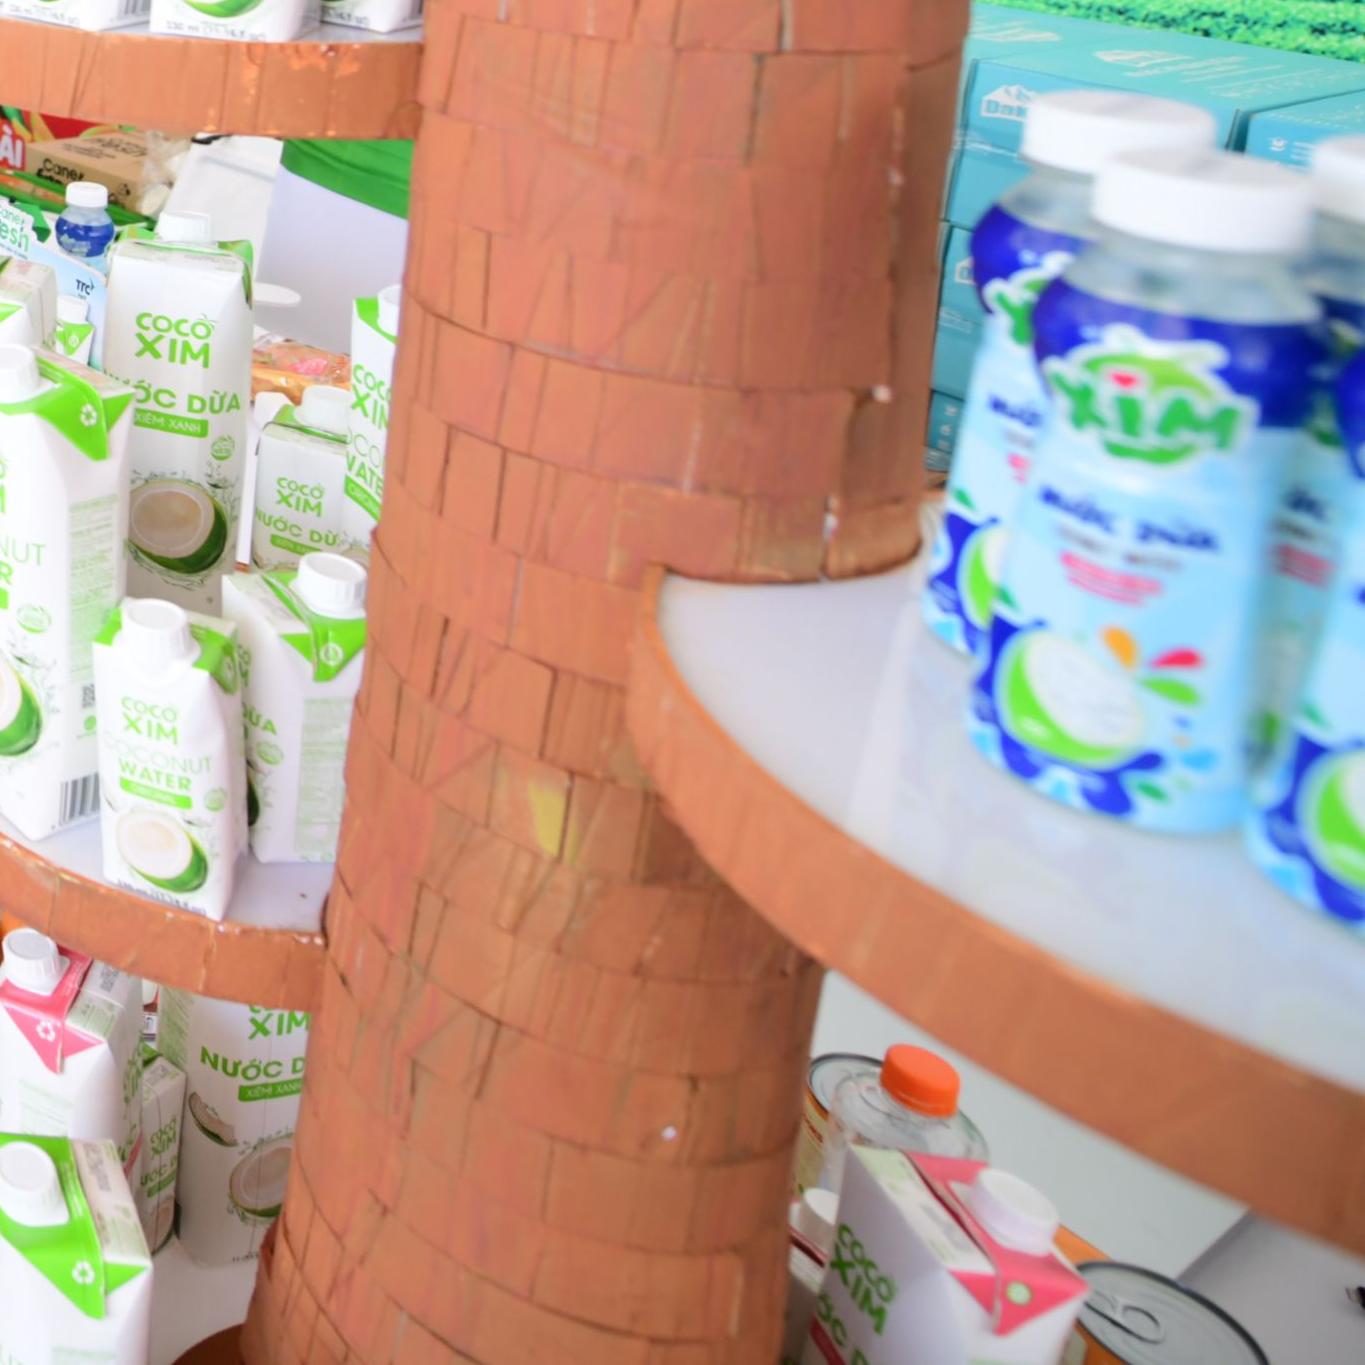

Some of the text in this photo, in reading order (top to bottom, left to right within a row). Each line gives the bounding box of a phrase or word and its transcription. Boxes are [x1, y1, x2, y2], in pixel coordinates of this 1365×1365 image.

[75, 279, 91, 296] TTC
[135, 332, 210, 369] XIM
[276, 489, 323, 518] XIM
[122, 712, 179, 746] XIM
[118, 757, 193, 792] WATER
[248, 1010, 310, 1040] XIM
[200, 1045, 284, 1082] NƯỚC
